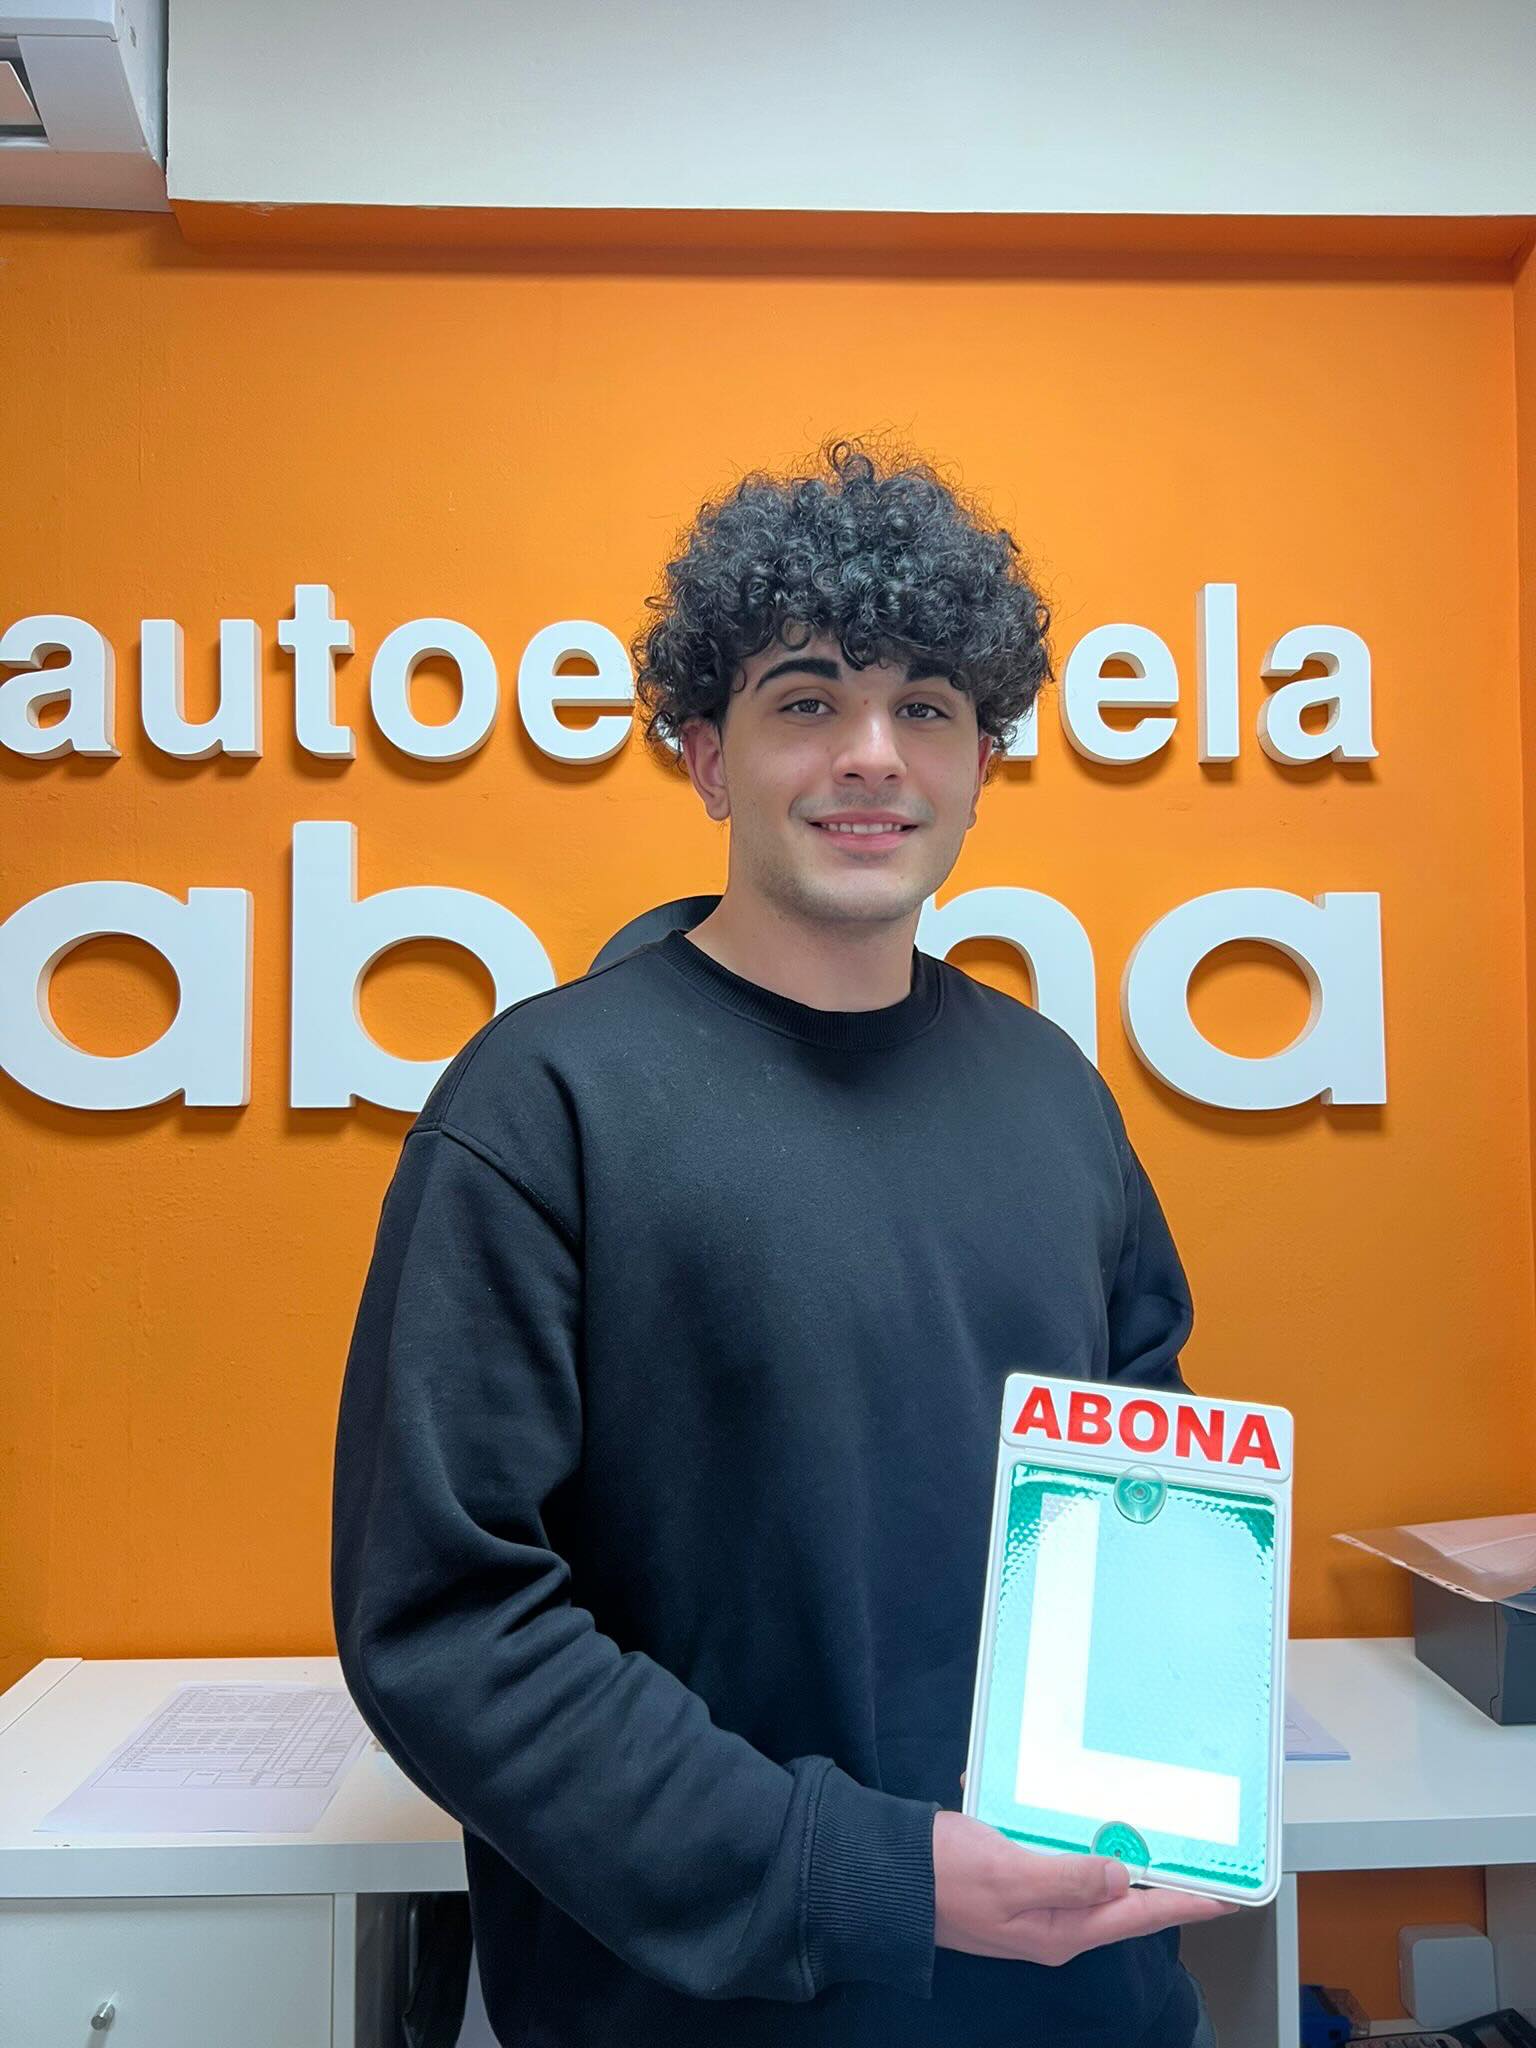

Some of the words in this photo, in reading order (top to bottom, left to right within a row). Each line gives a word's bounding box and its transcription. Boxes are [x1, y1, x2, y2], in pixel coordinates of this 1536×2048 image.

[0, 582, 1379, 765] autoeela
[0, 820, 1387, 1112] abna
[1012, 1386, 1281, 1471] ABONA
[1014, 1493, 1240, 1846] L
